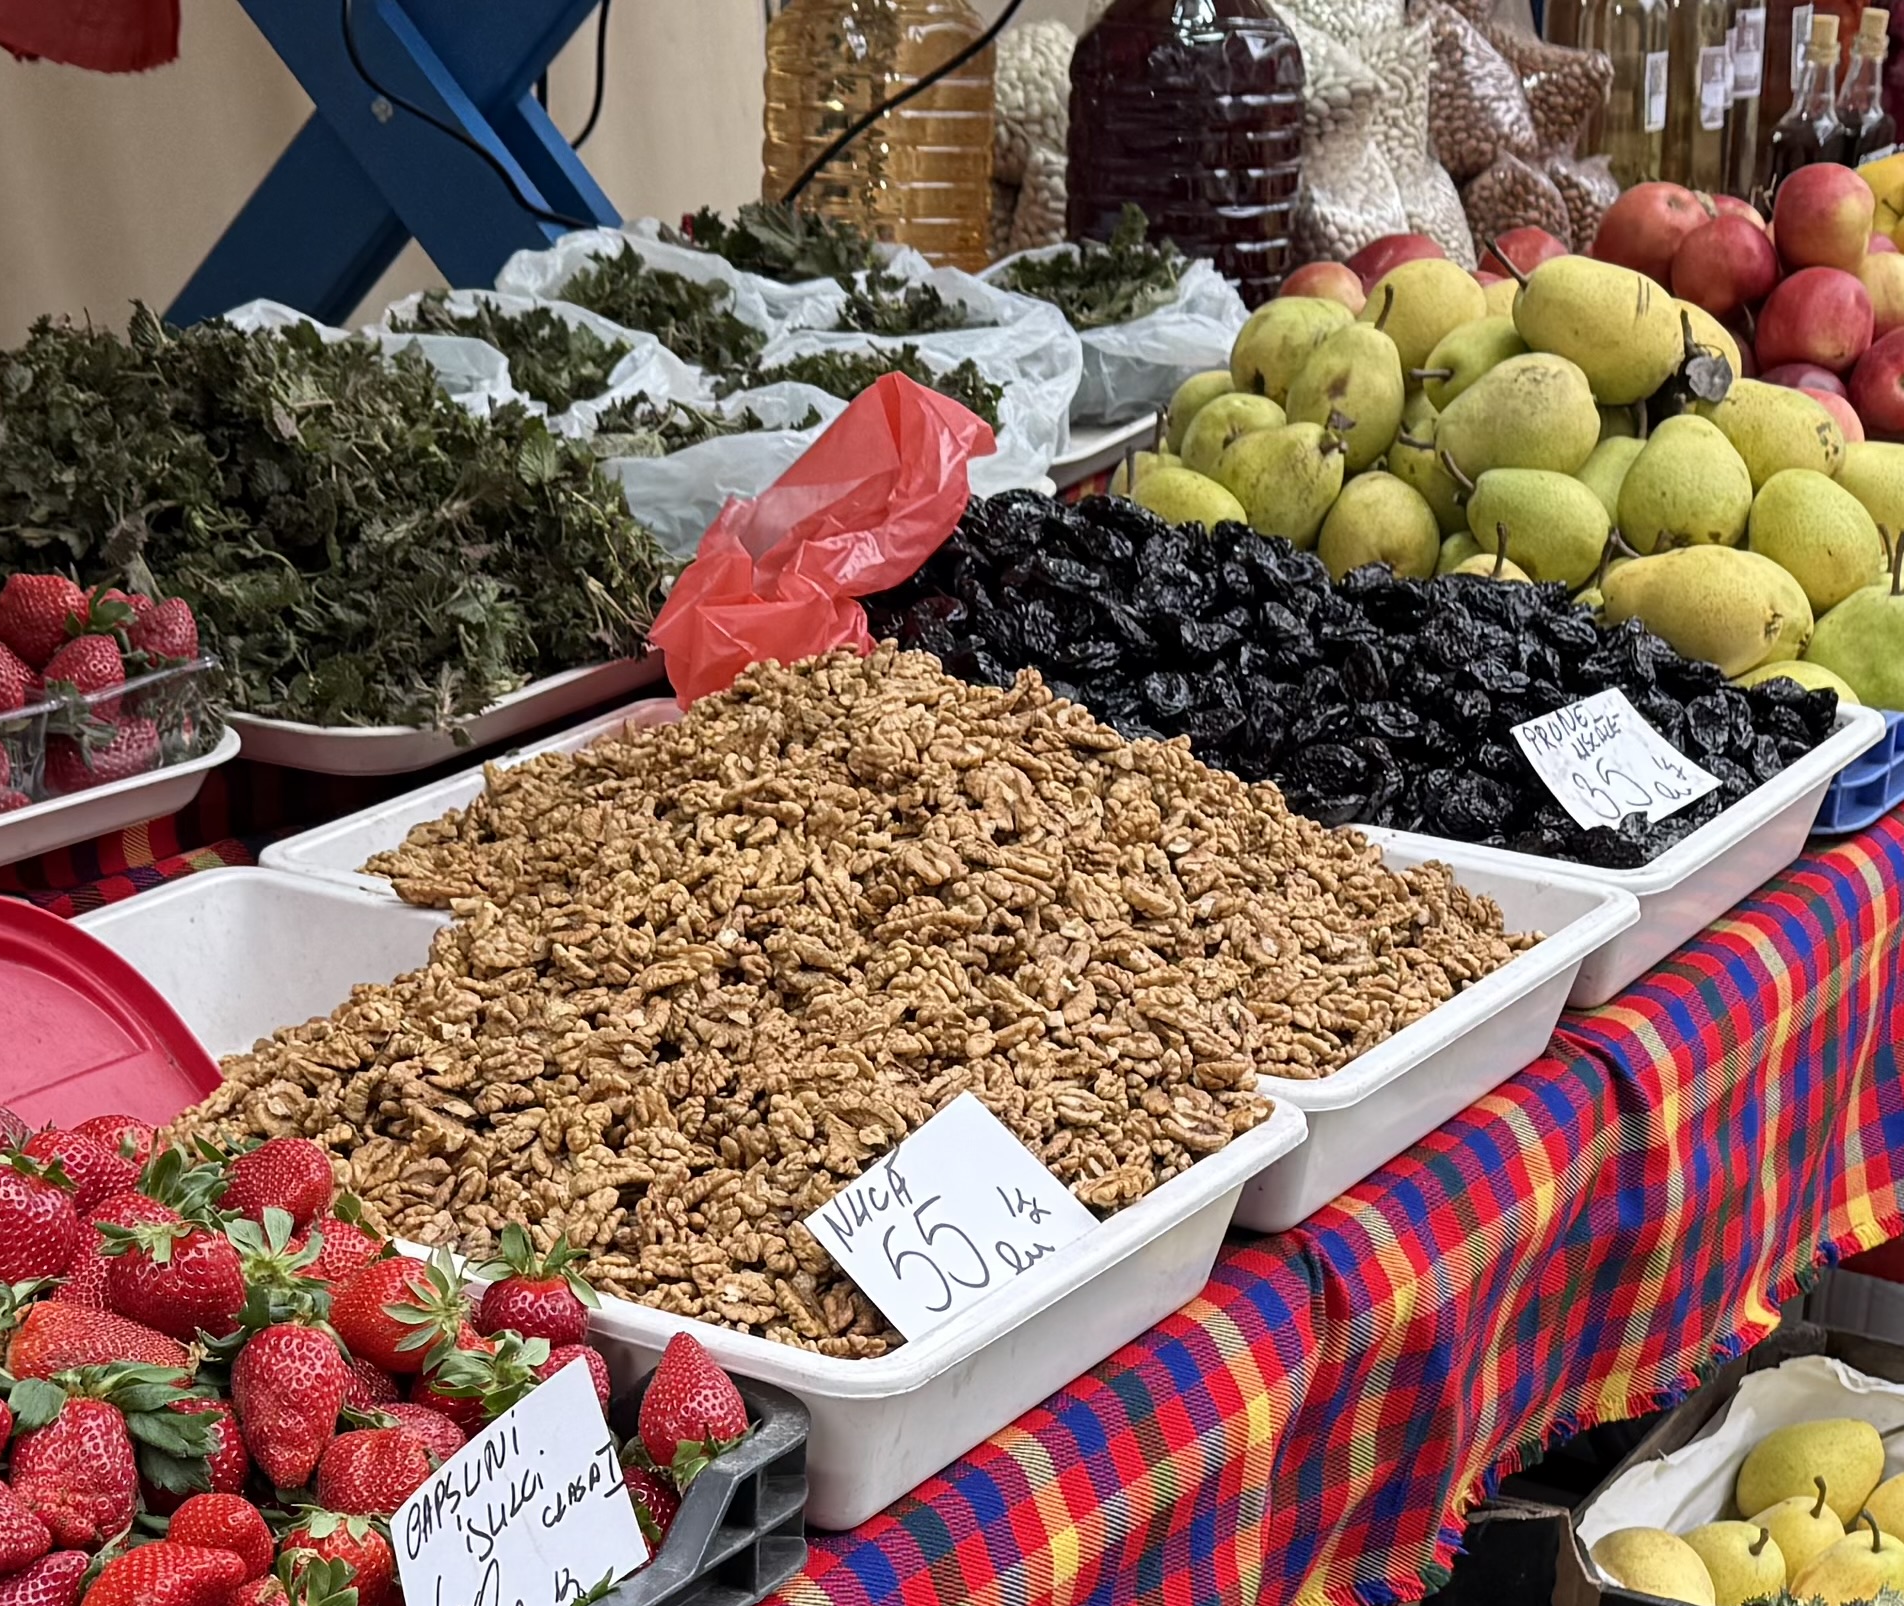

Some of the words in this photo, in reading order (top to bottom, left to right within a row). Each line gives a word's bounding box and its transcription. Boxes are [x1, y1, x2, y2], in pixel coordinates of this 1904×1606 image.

[1522, 703, 1588, 756] PRUNE
[1572, 757, 1653, 820] 35
[882, 1195, 991, 1313] 55
